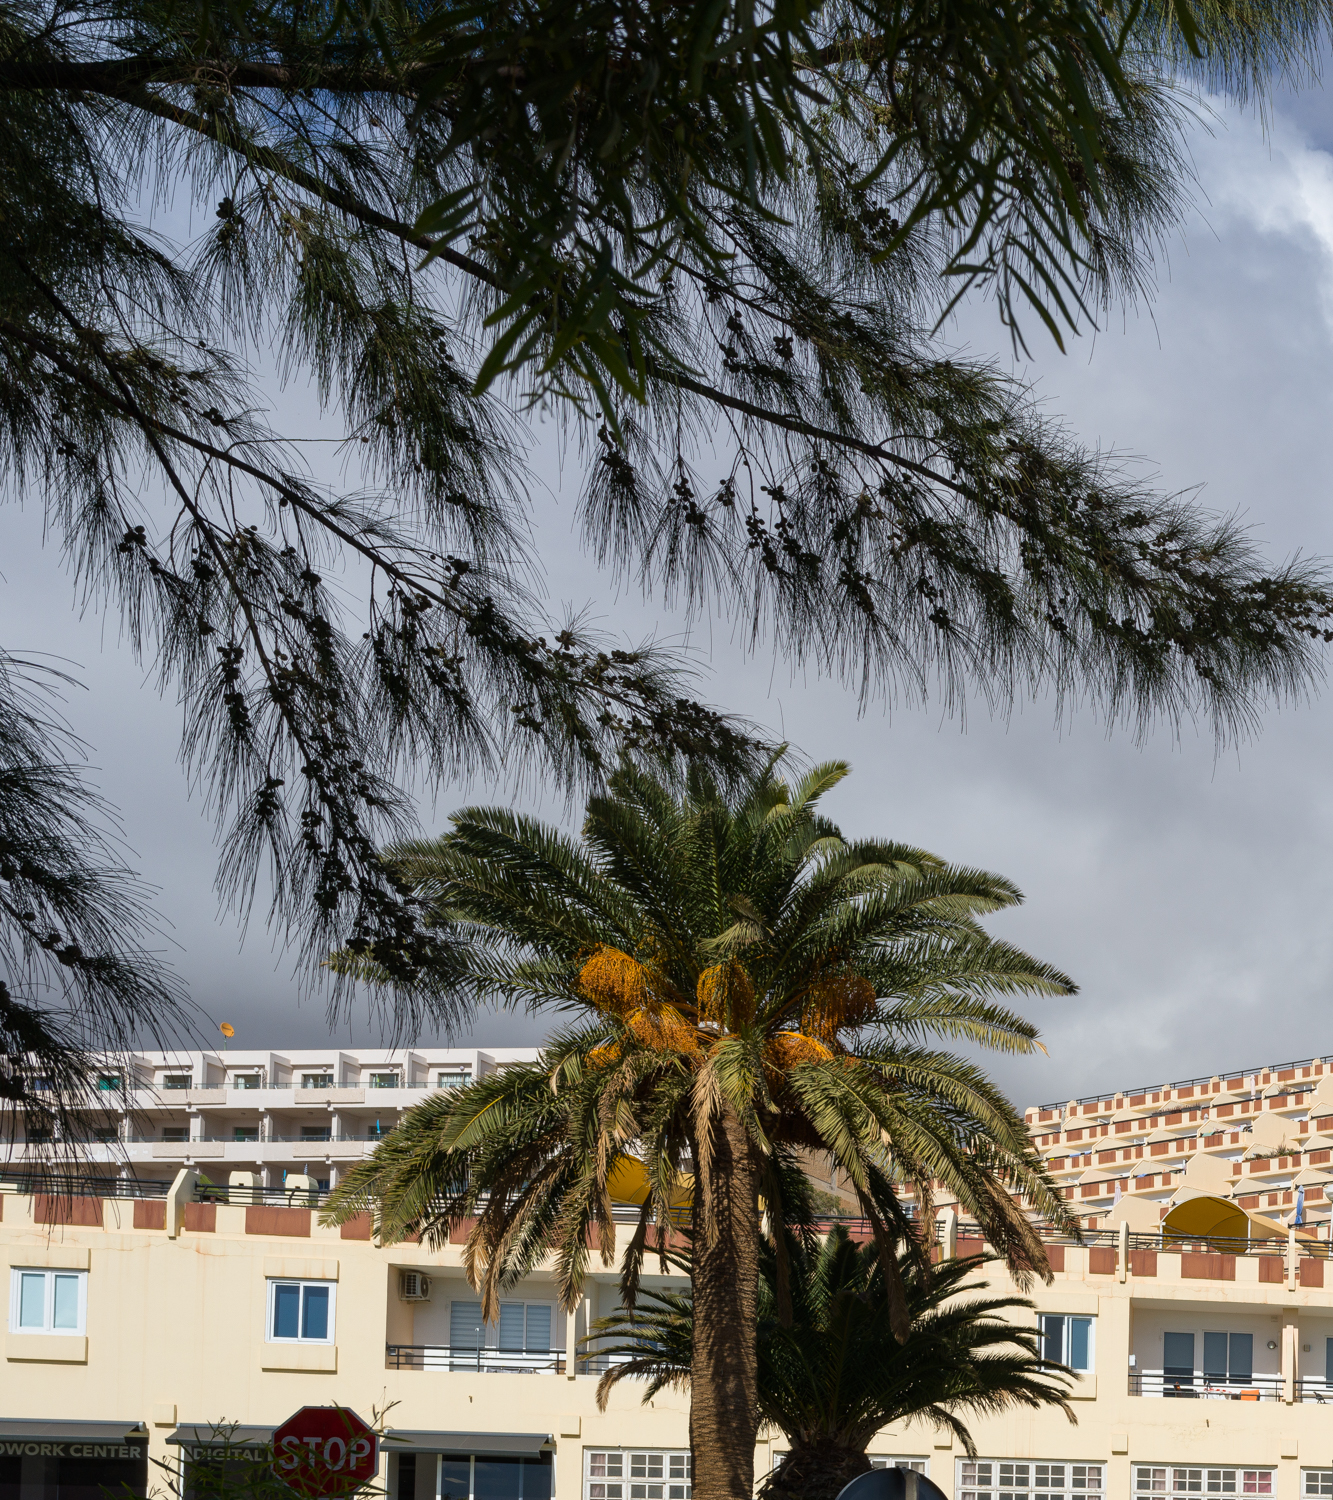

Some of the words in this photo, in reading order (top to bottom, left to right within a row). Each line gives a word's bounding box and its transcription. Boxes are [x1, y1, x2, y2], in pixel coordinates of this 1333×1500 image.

[69, 1443, 142, 1459] CENTER
[193, 1447, 263, 1463] DIGITAL
[279, 1434, 371, 1471] STOP
